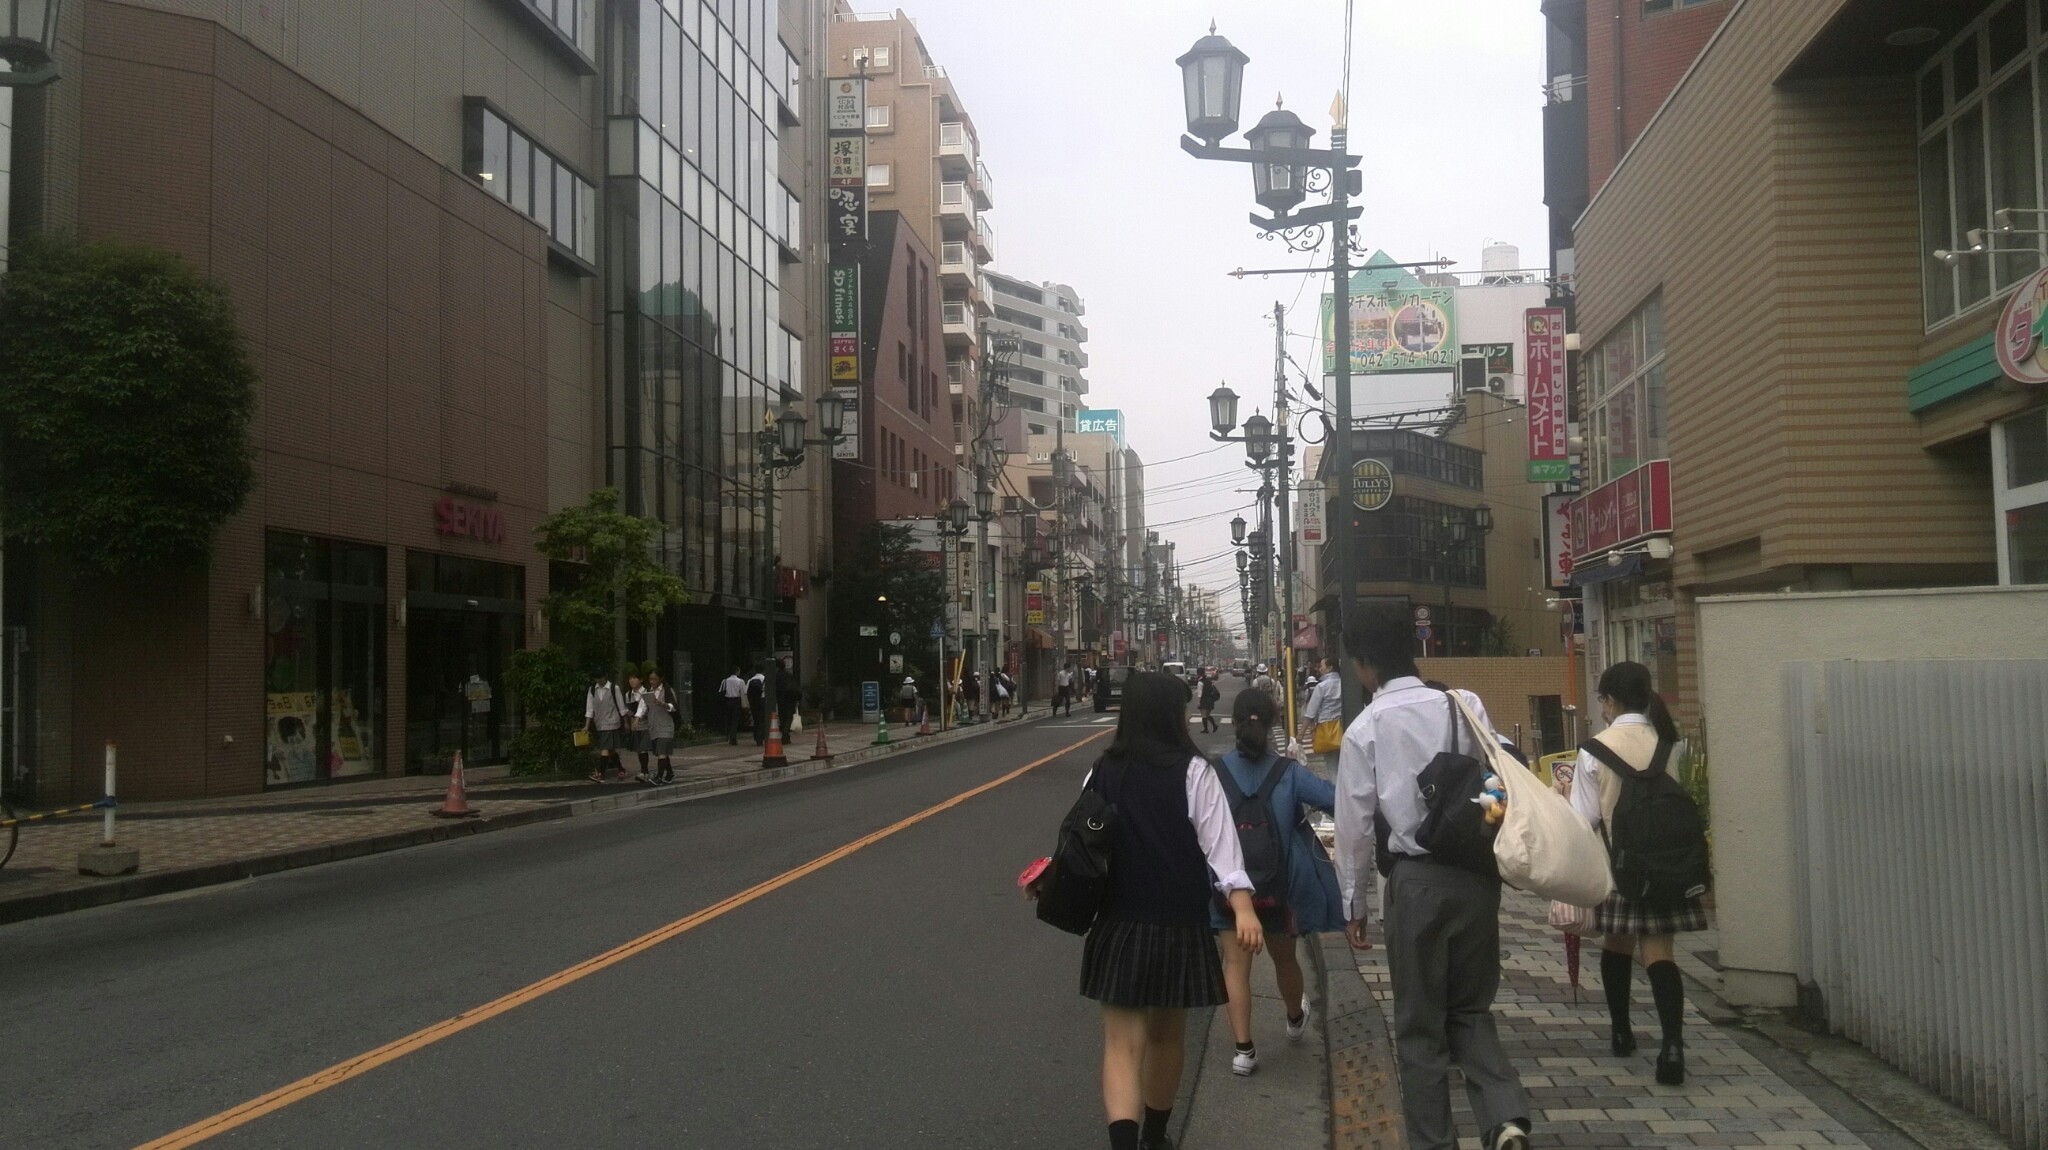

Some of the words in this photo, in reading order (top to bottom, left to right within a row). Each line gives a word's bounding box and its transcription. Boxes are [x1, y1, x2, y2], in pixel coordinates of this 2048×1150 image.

[833, 345, 855, 353] さくら
[1360, 352, 1384, 369] 042
[1392, 351, 1416, 367] 574
[1425, 349, 1455, 365] 1021
[1530, 339, 1550, 456] ホームメイト
[1079, 418, 1118, 433] 貸広告
[1352, 478, 1390, 489] TULLY'S
[434, 496, 506, 544] SEKIYA
